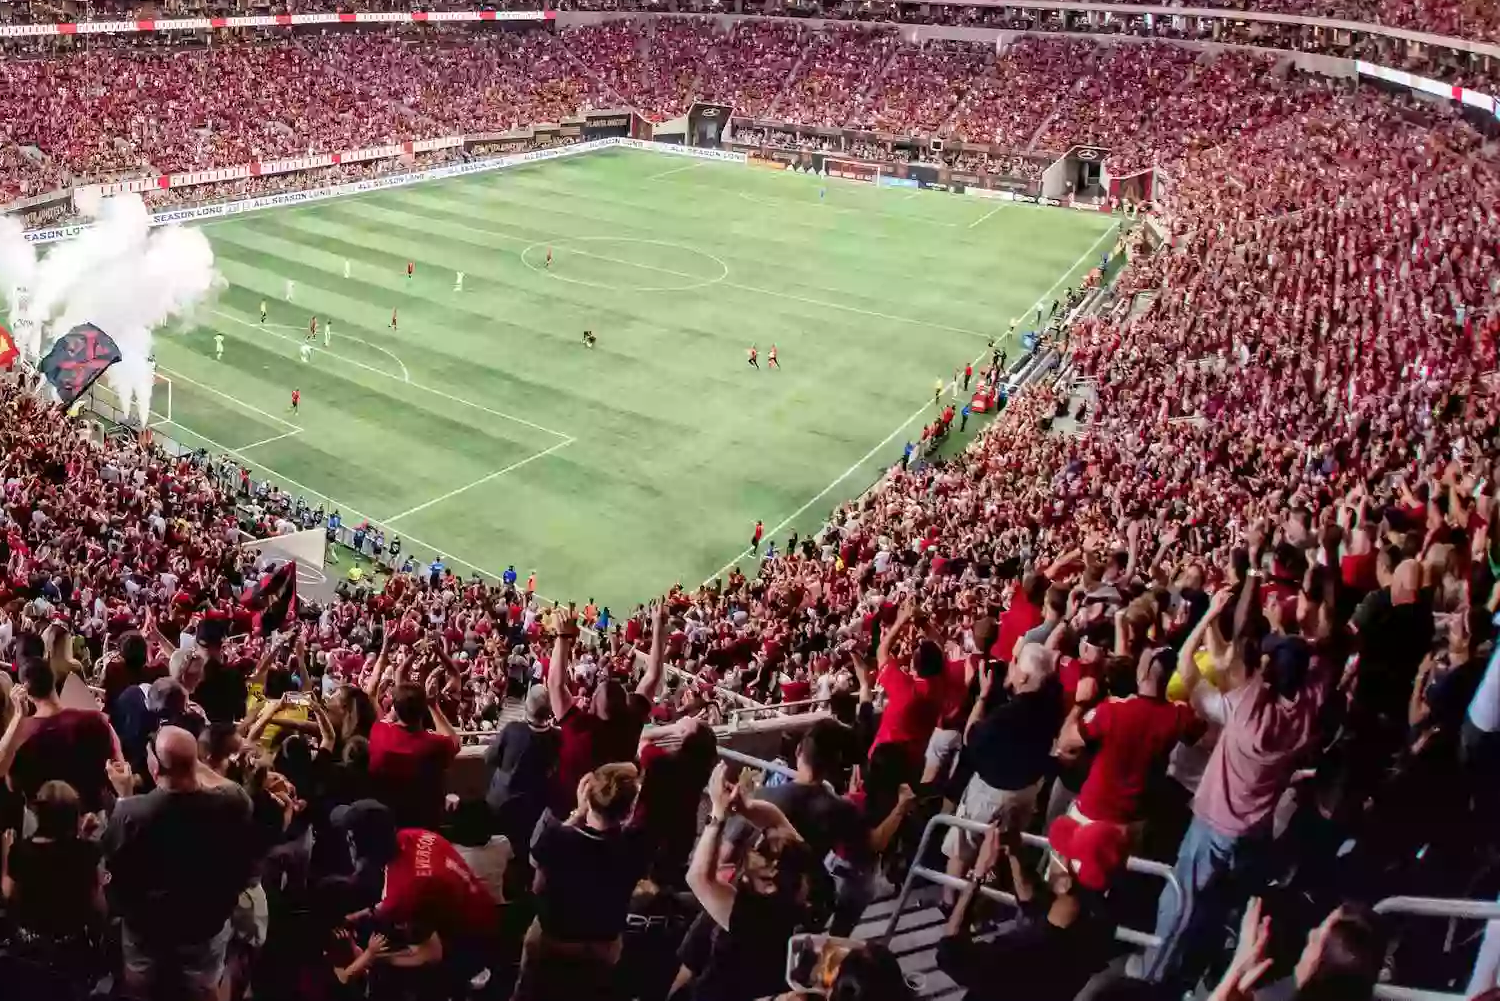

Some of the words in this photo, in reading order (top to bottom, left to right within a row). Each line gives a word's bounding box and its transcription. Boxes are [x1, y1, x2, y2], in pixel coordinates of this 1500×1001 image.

[153, 207, 194, 224] SEASON
[196, 204, 223, 217] LONG
[24, 229, 63, 242] EASON
